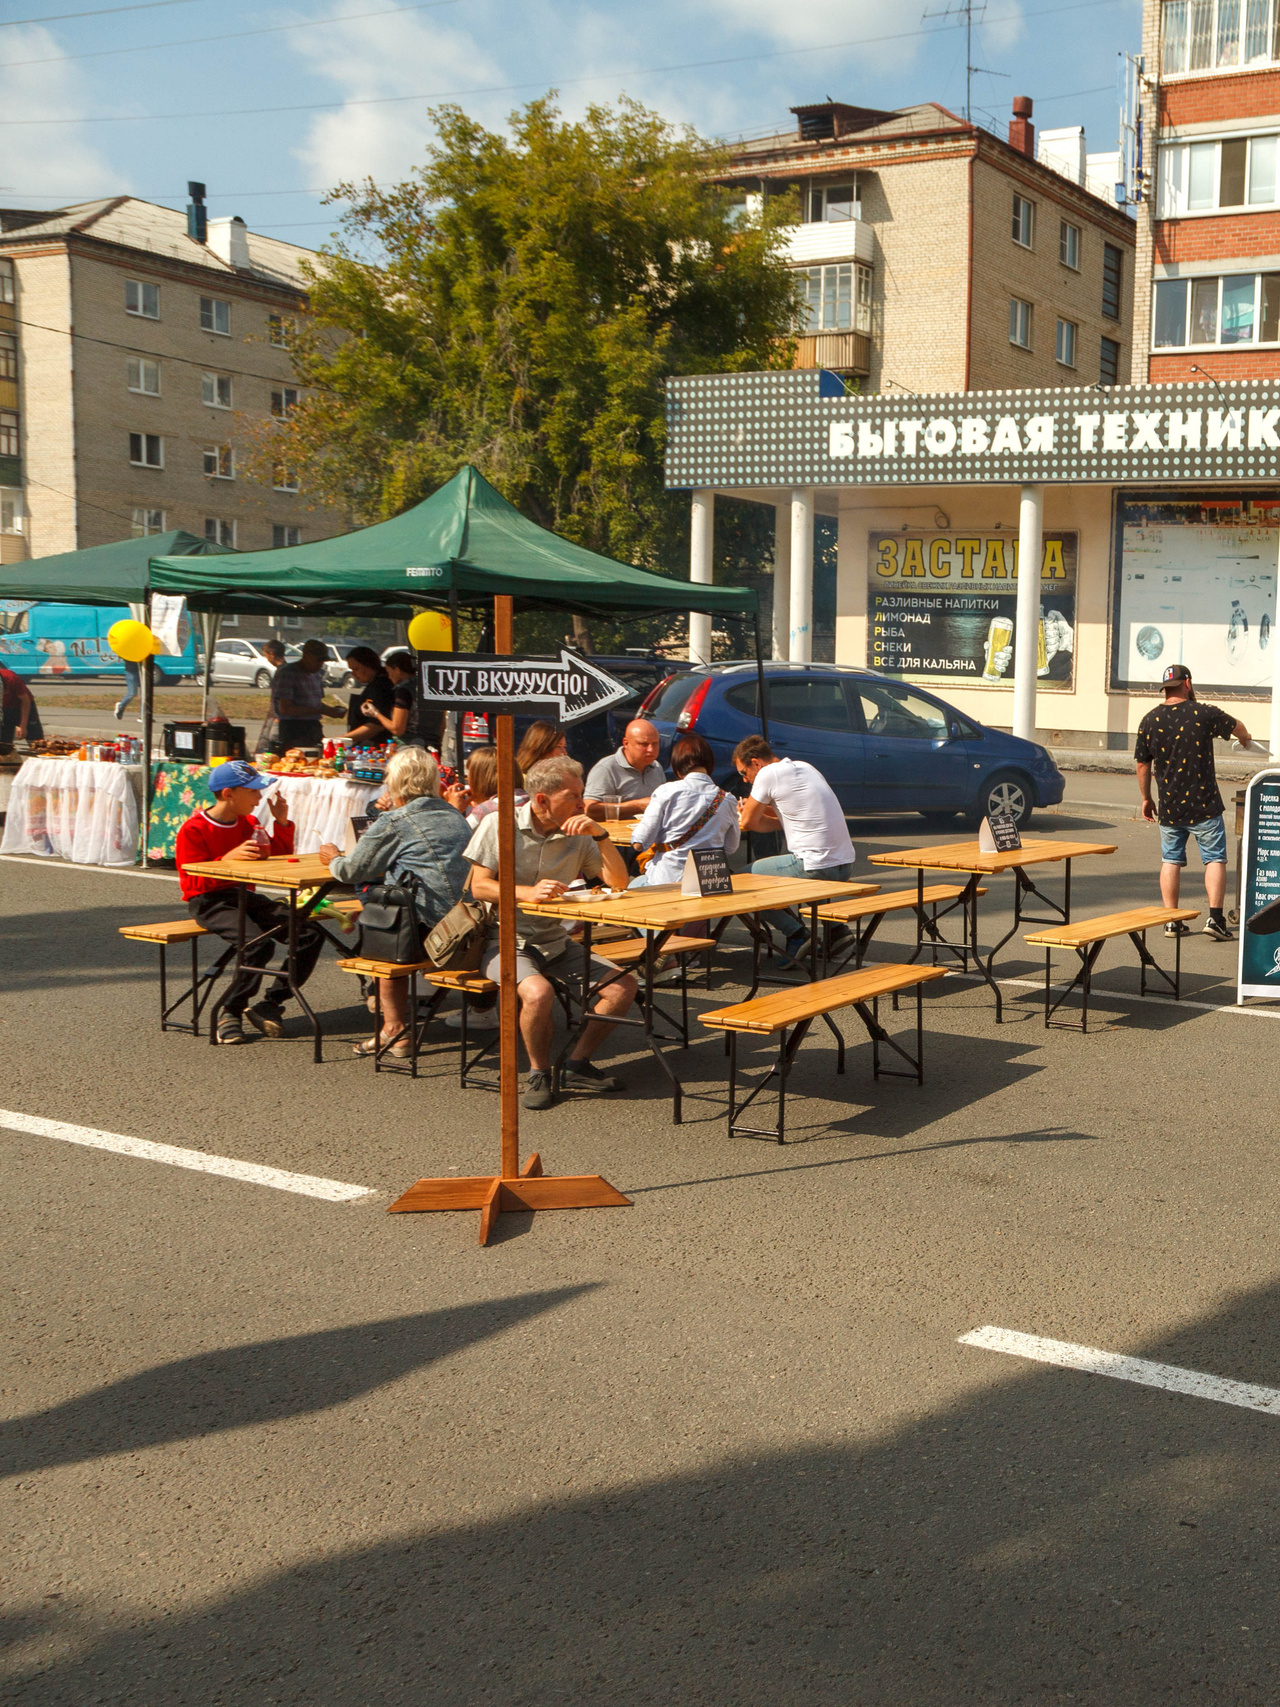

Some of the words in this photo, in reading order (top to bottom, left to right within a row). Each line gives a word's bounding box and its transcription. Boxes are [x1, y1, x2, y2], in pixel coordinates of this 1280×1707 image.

[828, 415, 1054, 458] БЫТОВАЯ
[876, 538, 1067, 579] ЗАСТАА
[875, 597, 943, 609] РАЗЛИВНЫЕ
[945, 599, 999, 610] НАПИТКИ
[874, 612, 931, 624] ЛИМОНАД
[874, 627, 906, 637] РЫБА
[874, 642, 912, 653] СНЕКИ
[874, 655, 895, 667] ВСЁ
[897, 657, 921, 668] ДЛЯ
[923, 659, 976, 671] КАЛЬЯНА
[435, 669, 470, 693] ТУТ
[477, 670, 588, 696] ВКУУУУСНО!
